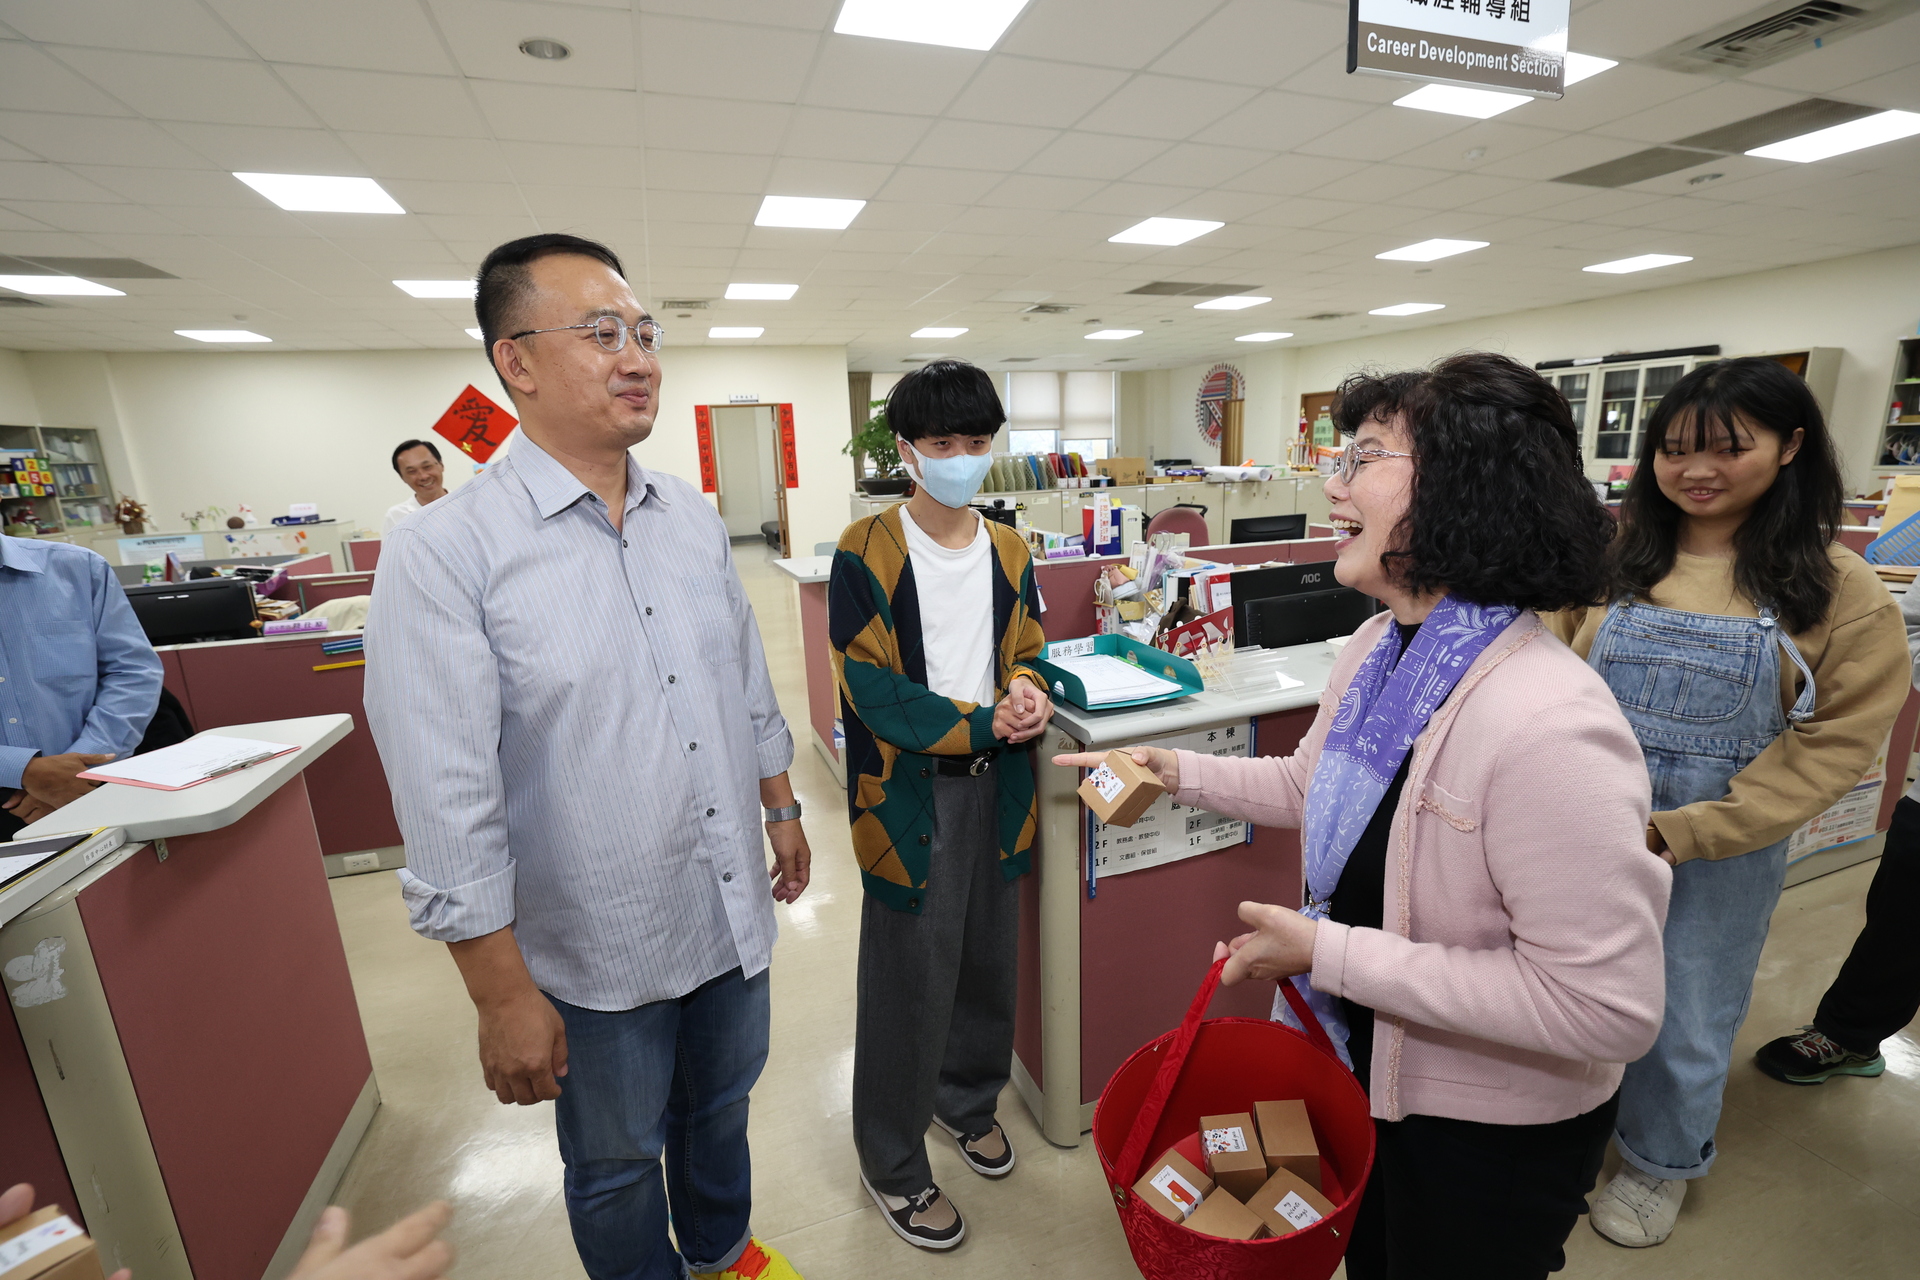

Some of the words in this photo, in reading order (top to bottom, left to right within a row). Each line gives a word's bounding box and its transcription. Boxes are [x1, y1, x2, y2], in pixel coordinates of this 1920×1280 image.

[1408, 0, 1530, 23] 輔導組
[1367, 31, 1417, 58] Career
[1418, 39, 1509, 72] Development
[1510, 53, 1559, 78] Section
[14, 460, 23, 470] 1
[27, 460, 36, 470] 2
[39, 460, 48, 470] 3
[19, 473, 27, 482] 4
[30, 473, 39, 483] 5
[43, 473, 51, 482] 6
[21, 486, 30, 495] 7
[34, 485, 42, 496] 8
[1300, 572, 1321, 584] AOC
[1050, 641, 1094, 658] 服務學習
[1207, 727, 1236, 742] 本棟
[1283, 1201, 1292, 1209] my
[1294, 1208, 1309, 1221] things
